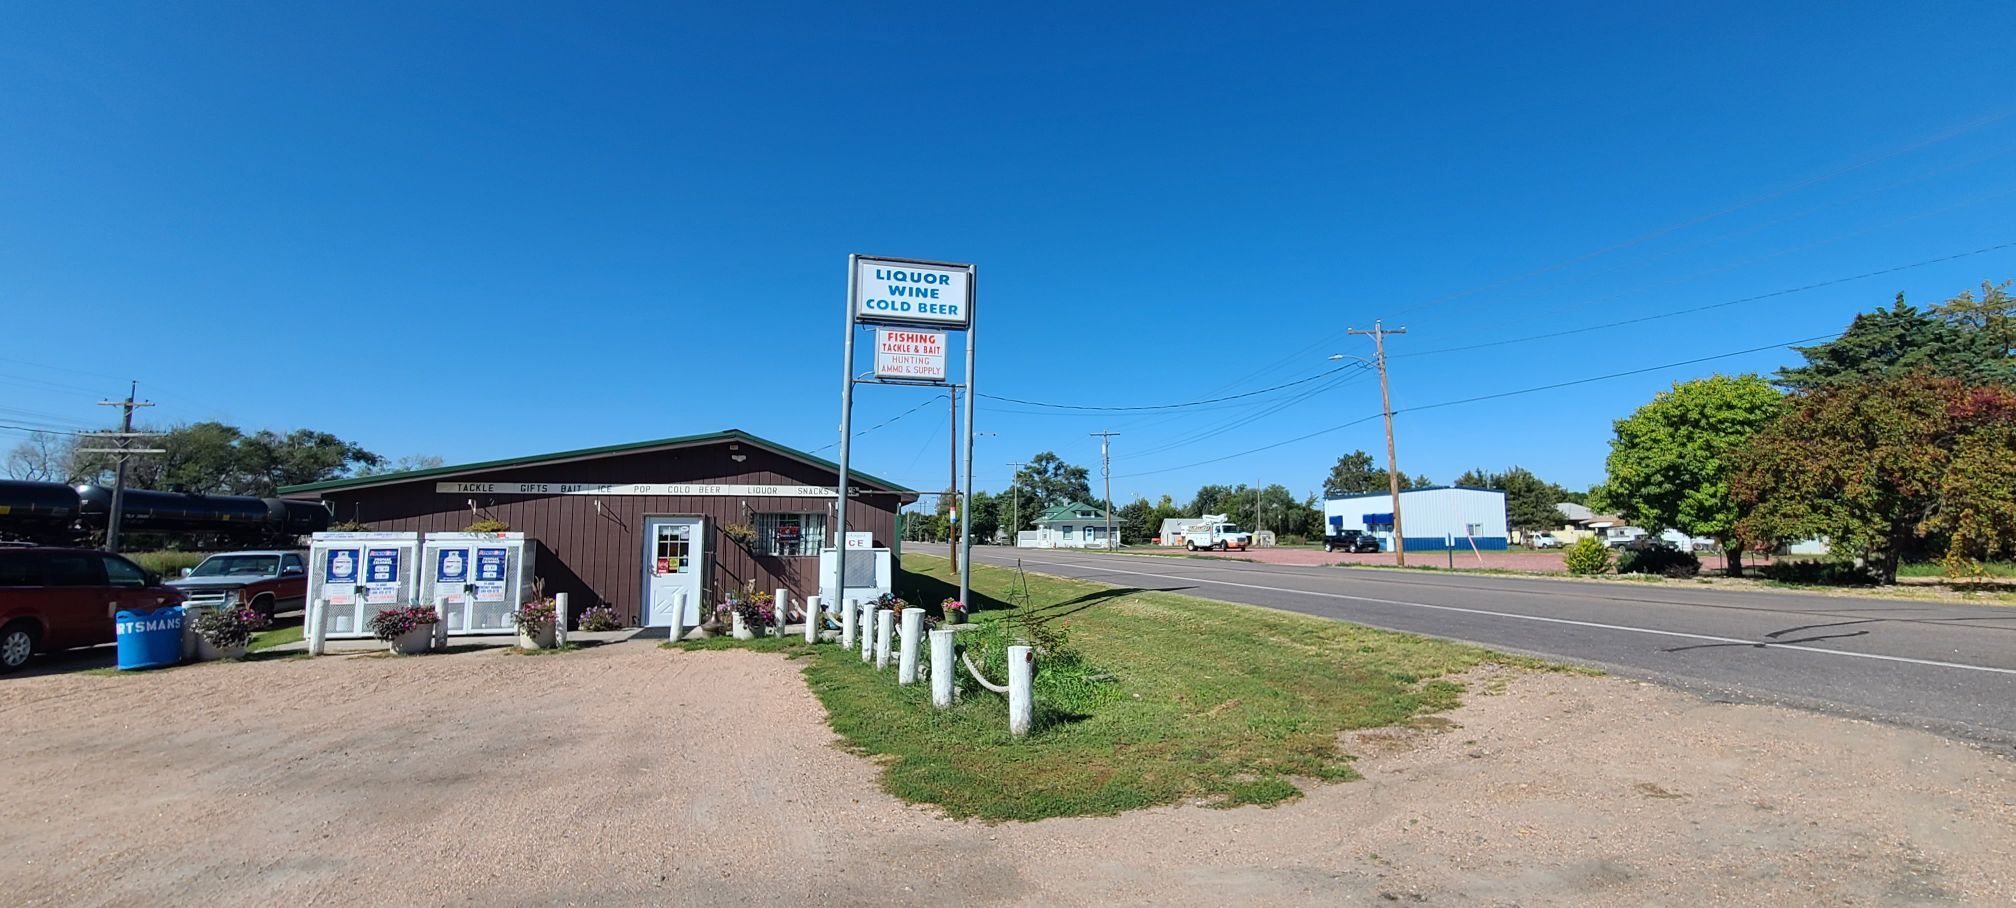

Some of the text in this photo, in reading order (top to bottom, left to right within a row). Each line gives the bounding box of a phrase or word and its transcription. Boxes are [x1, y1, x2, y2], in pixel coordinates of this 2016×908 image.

[876, 269, 950, 285] LIQUOR
[888, 285, 940, 299] WINE
[866, 299, 958, 315] COLD BEER
[887, 332, 936, 344] FISHING
[882, 343, 911, 354] TACKLE
[923, 346, 941, 354] BAIT
[892, 356, 930, 365] HUNTING
[881, 365, 903, 373] AMMO
[913, 366, 941, 375] SUPPLY
[457, 484, 494, 492] TACKLE
[520, 484, 548, 493] GIFTS
[560, 485, 582, 493] BAIT
[597, 485, 612, 493] ICE
[633, 485, 651, 493] POP
[667, 486, 690, 494] COLD
[699, 486, 721, 494] BEER
[747, 487, 778, 495] LIQUOR
[797, 487, 829, 496] SNACKS
[848, 539, 864, 547] CE
